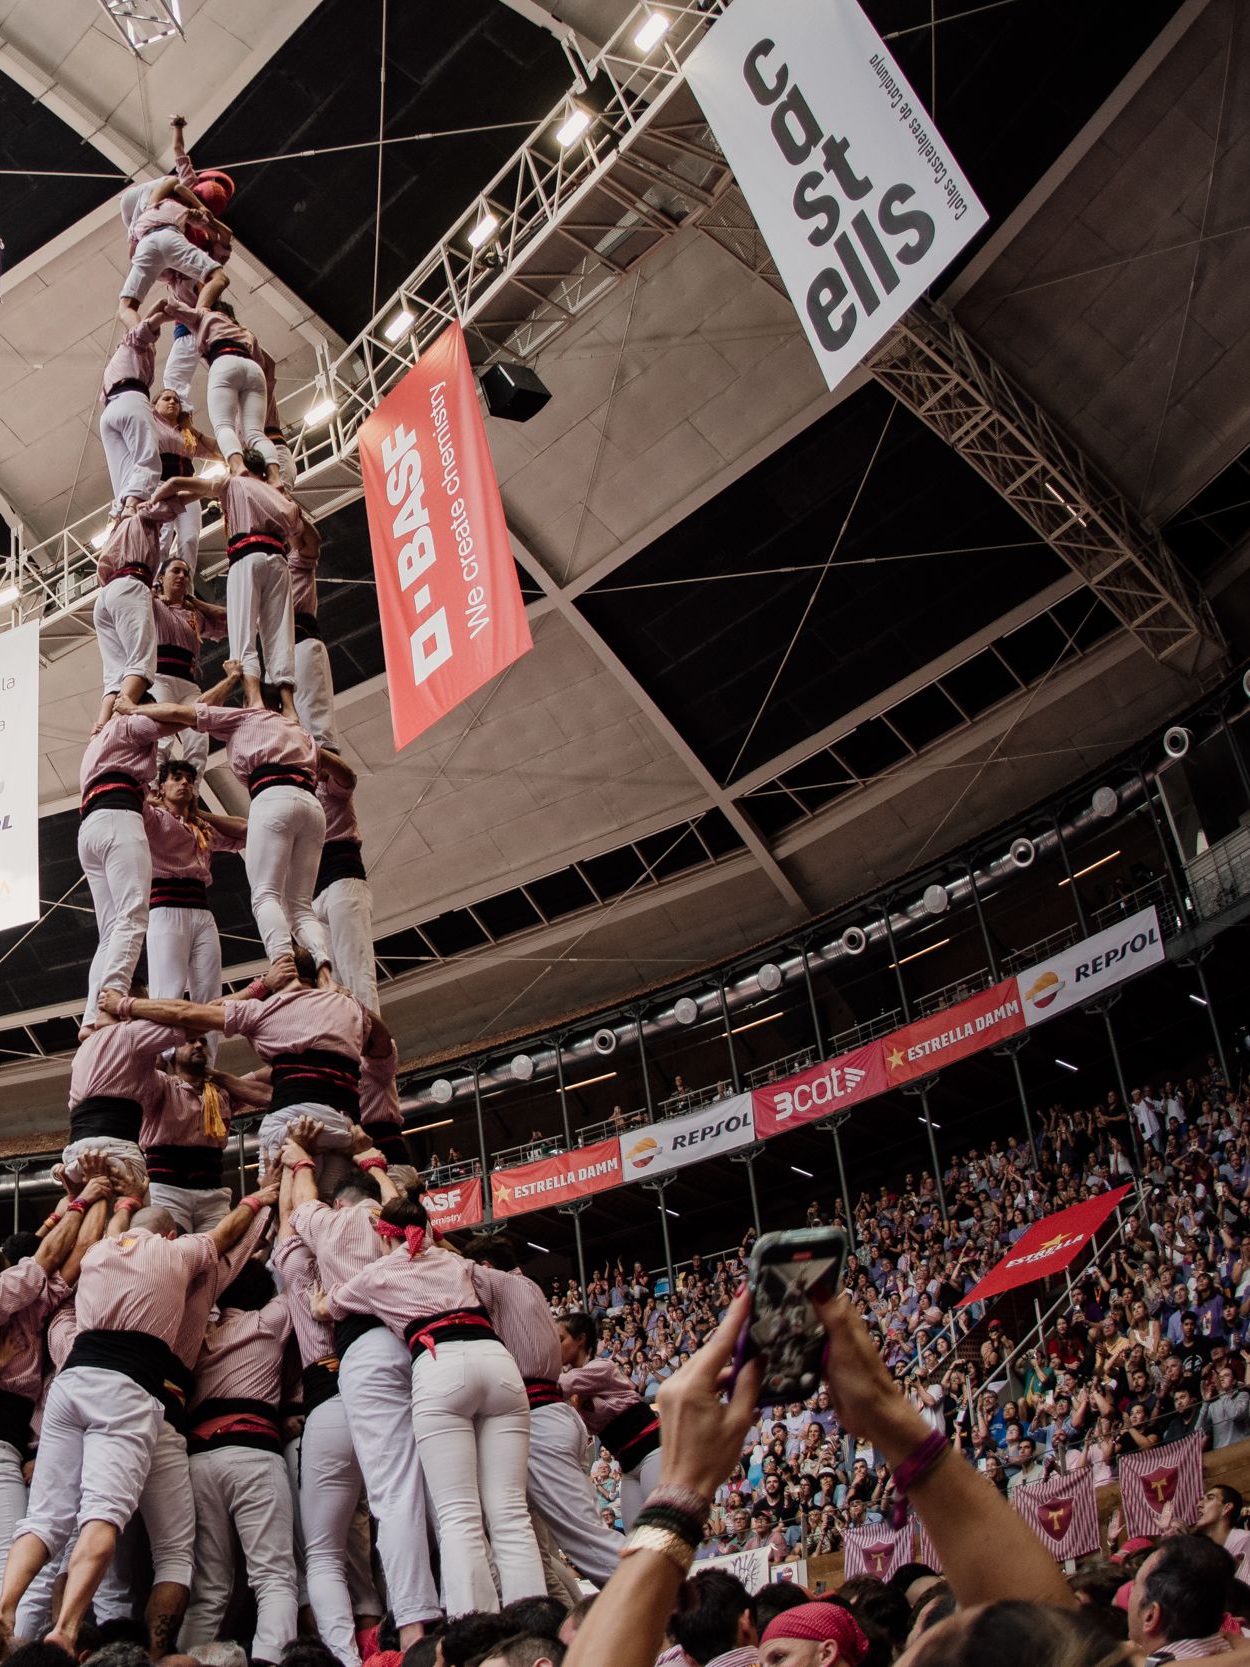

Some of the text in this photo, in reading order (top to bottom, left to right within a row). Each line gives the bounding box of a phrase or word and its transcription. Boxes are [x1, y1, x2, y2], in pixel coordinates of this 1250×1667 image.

[869, 54, 968, 221] Colles Castelleres de Catalunya
[381, 423, 437, 592] BASF
[429, 380, 490, 640] We create chemistry
[2, 677, 15, 691] la
[1075, 928, 1159, 983] REPSOL
[907, 1000, 1020, 1062] ESTRELLA DAMM
[774, 1067, 843, 1121] 3cat
[672, 1112, 753, 1150] REPSOL
[422, 1189, 461, 1211] ASF
[514, 1158, 618, 1199] ESTRELLA DAMM
[1006, 1233, 1084, 1268] ESTRELLA
